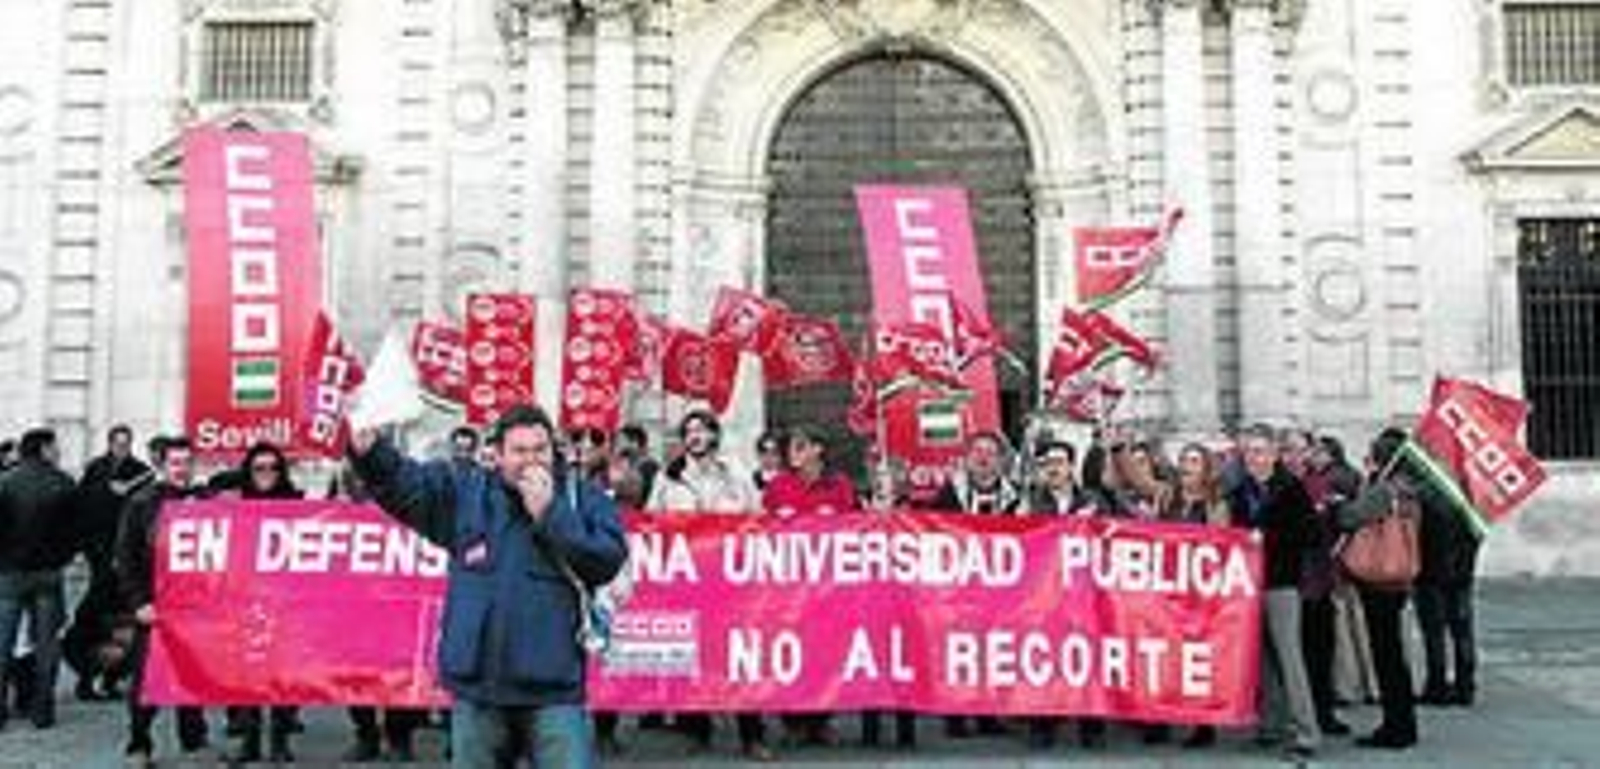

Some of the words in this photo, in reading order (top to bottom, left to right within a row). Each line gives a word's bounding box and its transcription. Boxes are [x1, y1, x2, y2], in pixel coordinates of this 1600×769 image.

[226, 145, 280, 351] CCOO
[197, 418, 298, 449] Sevill
[1436, 401, 1527, 495] CCOO
[169, 518, 230, 572] EN
[255, 518, 449, 577] DEFENS
[630, 531, 700, 583] NA
[722, 531, 1022, 586] UNIVERSIDAD
[1061, 521, 1257, 598] PÚBLICA
[728, 626, 801, 685] NO
[842, 624, 915, 684] AL
[945, 630, 1212, 697] RECORTE
